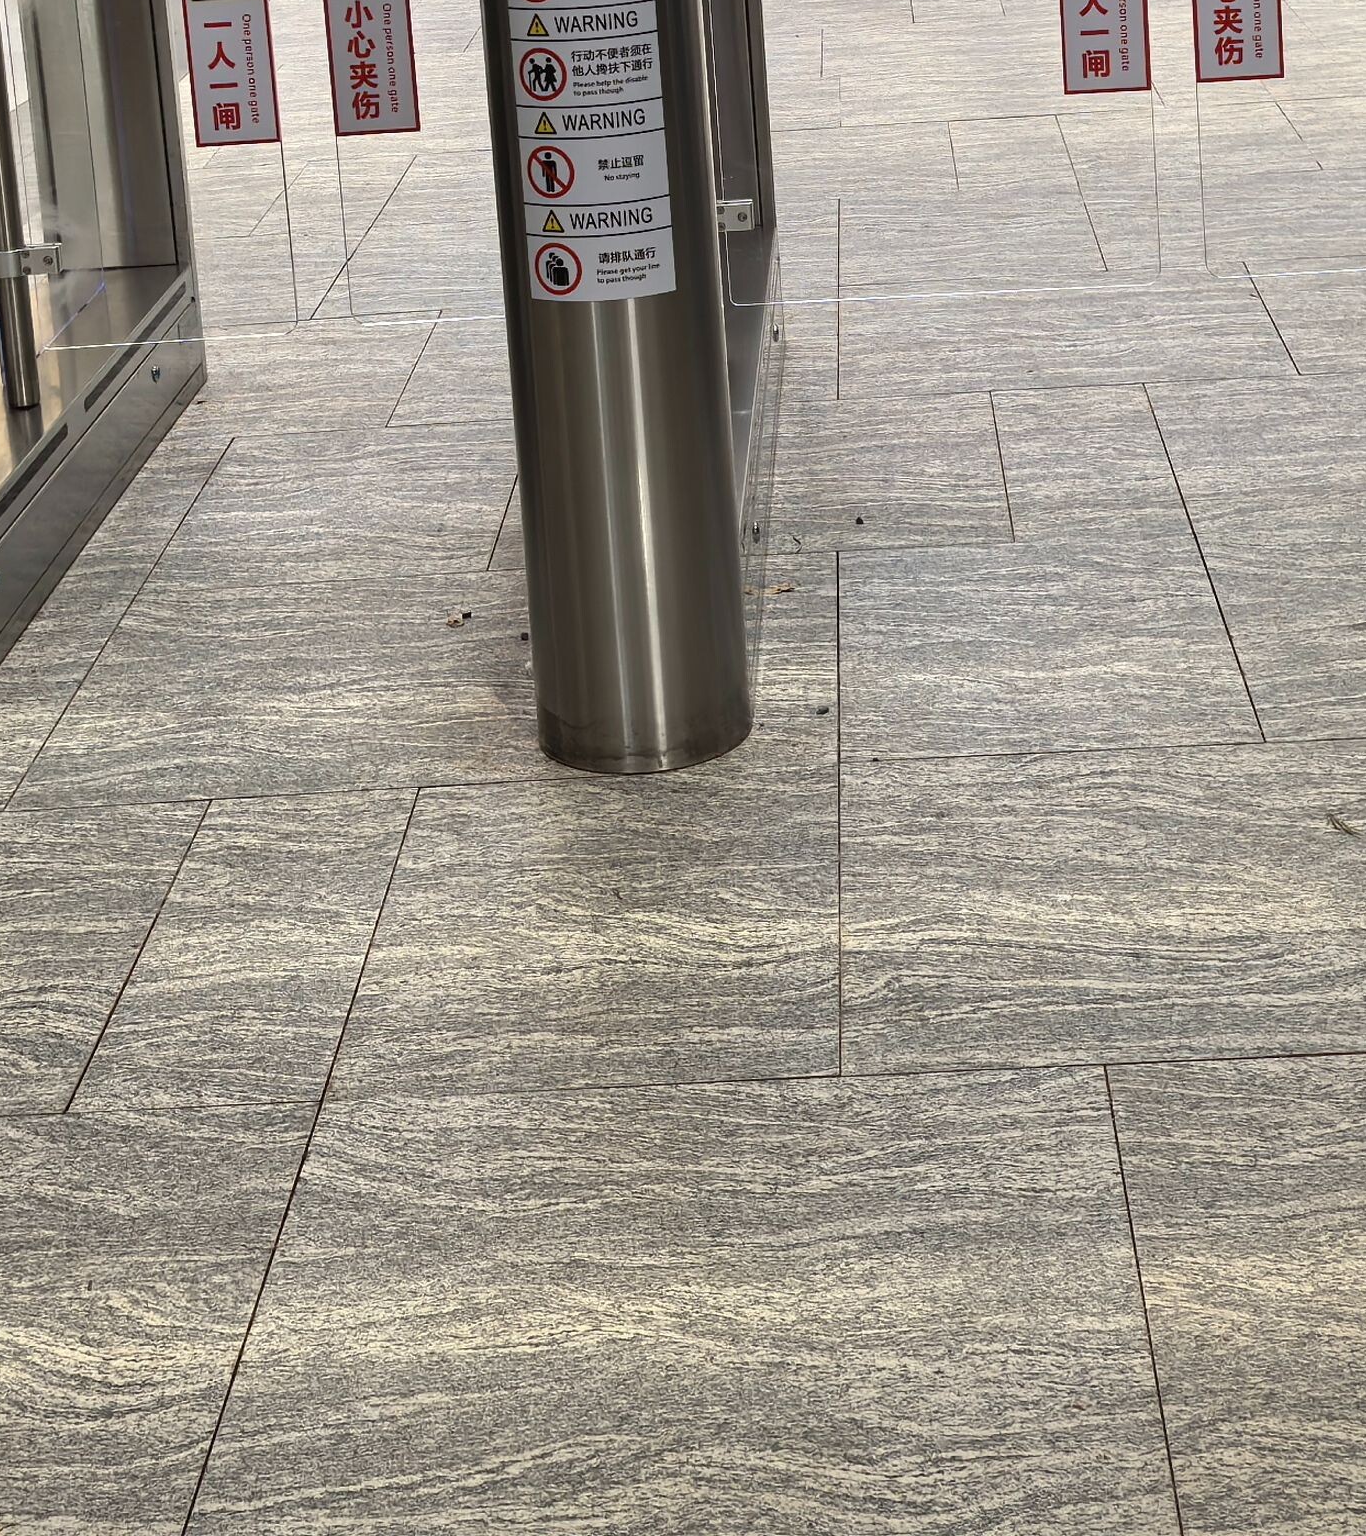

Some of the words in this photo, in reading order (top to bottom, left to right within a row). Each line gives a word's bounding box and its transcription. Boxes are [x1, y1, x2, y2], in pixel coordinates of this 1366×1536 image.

[554, 11, 638, 34] WARNING
[345, 0, 380, 120] 小心夹伤
[204, 21, 241, 131] 一人一闸
[582, 89, 598, 97] pass
[599, 87, 624, 95] though
[562, 108, 646, 131] WARNING
[569, 207, 653, 230] WARNING
[598, 246, 656, 264] 请排队通行
[622, 274, 647, 282] though
